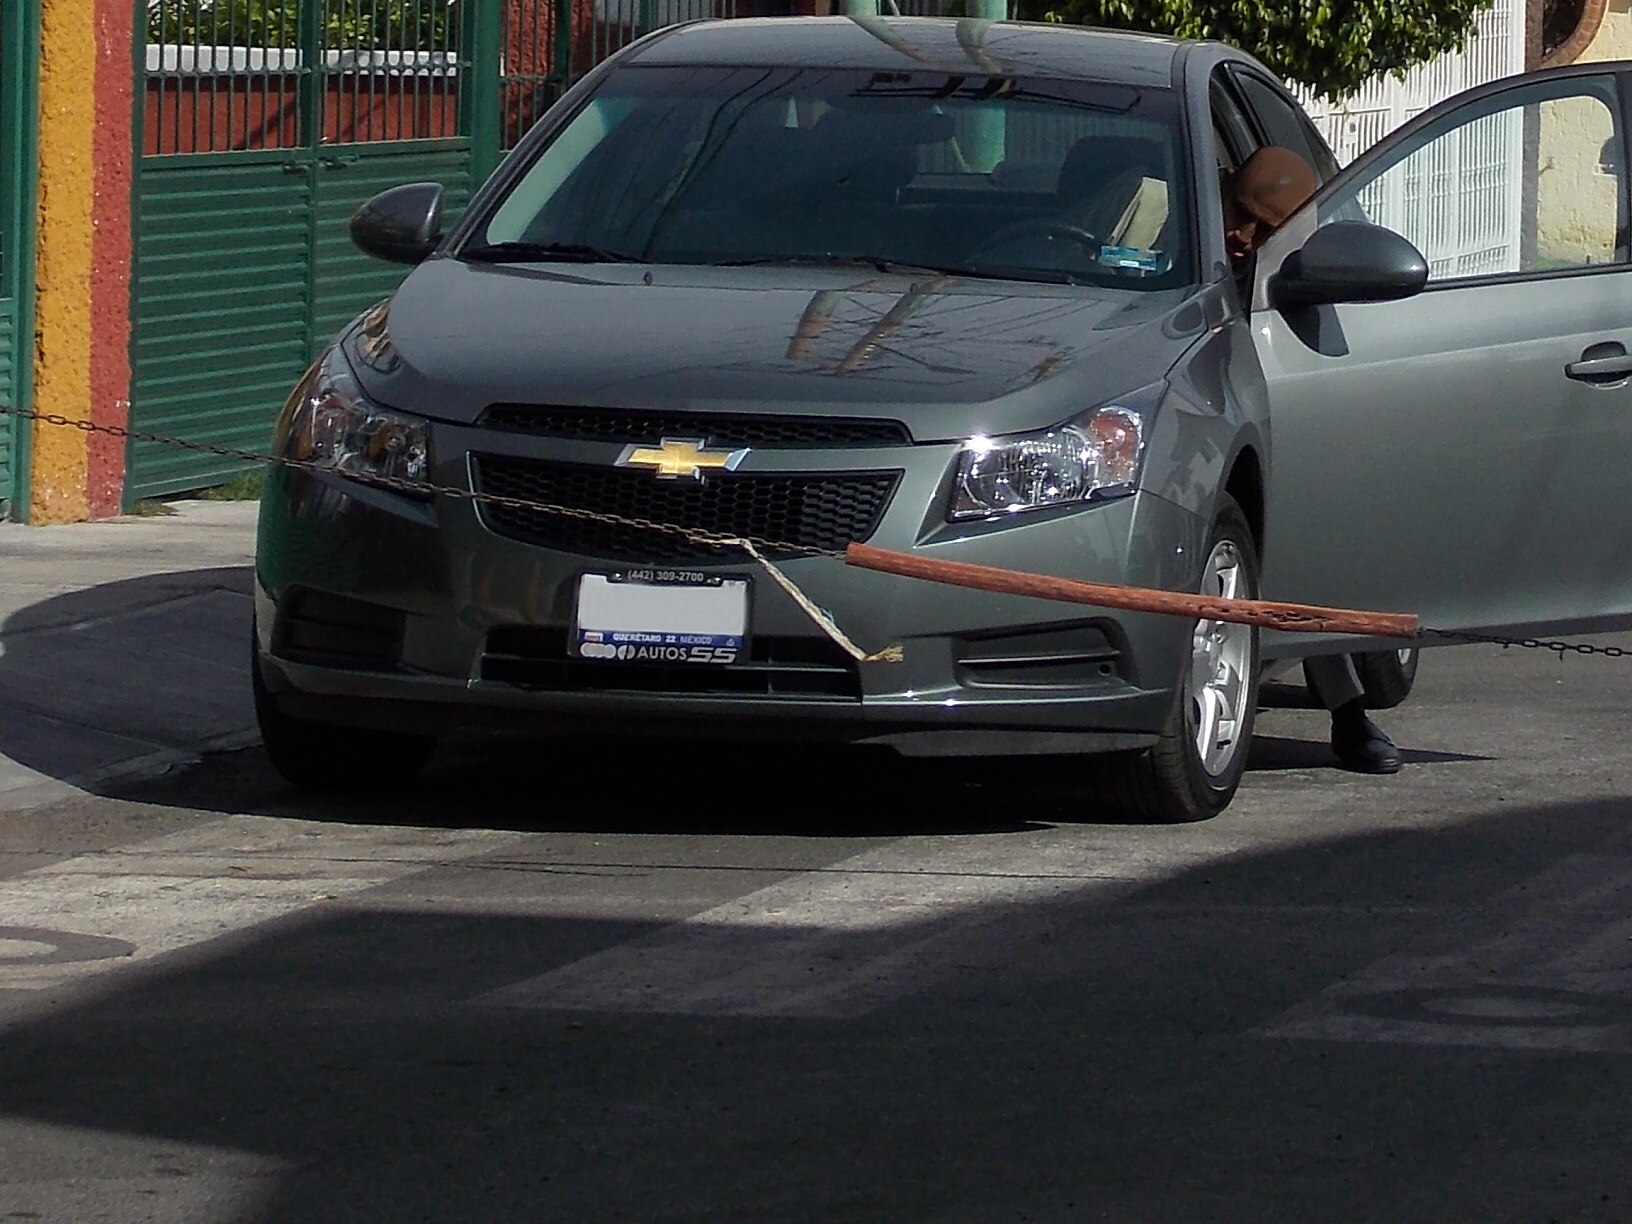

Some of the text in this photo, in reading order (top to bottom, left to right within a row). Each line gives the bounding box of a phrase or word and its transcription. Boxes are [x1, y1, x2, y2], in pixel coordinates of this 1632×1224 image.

[627, 569, 704, 582] (442) 309-2700
[637, 646, 687, 660] AUTOS
